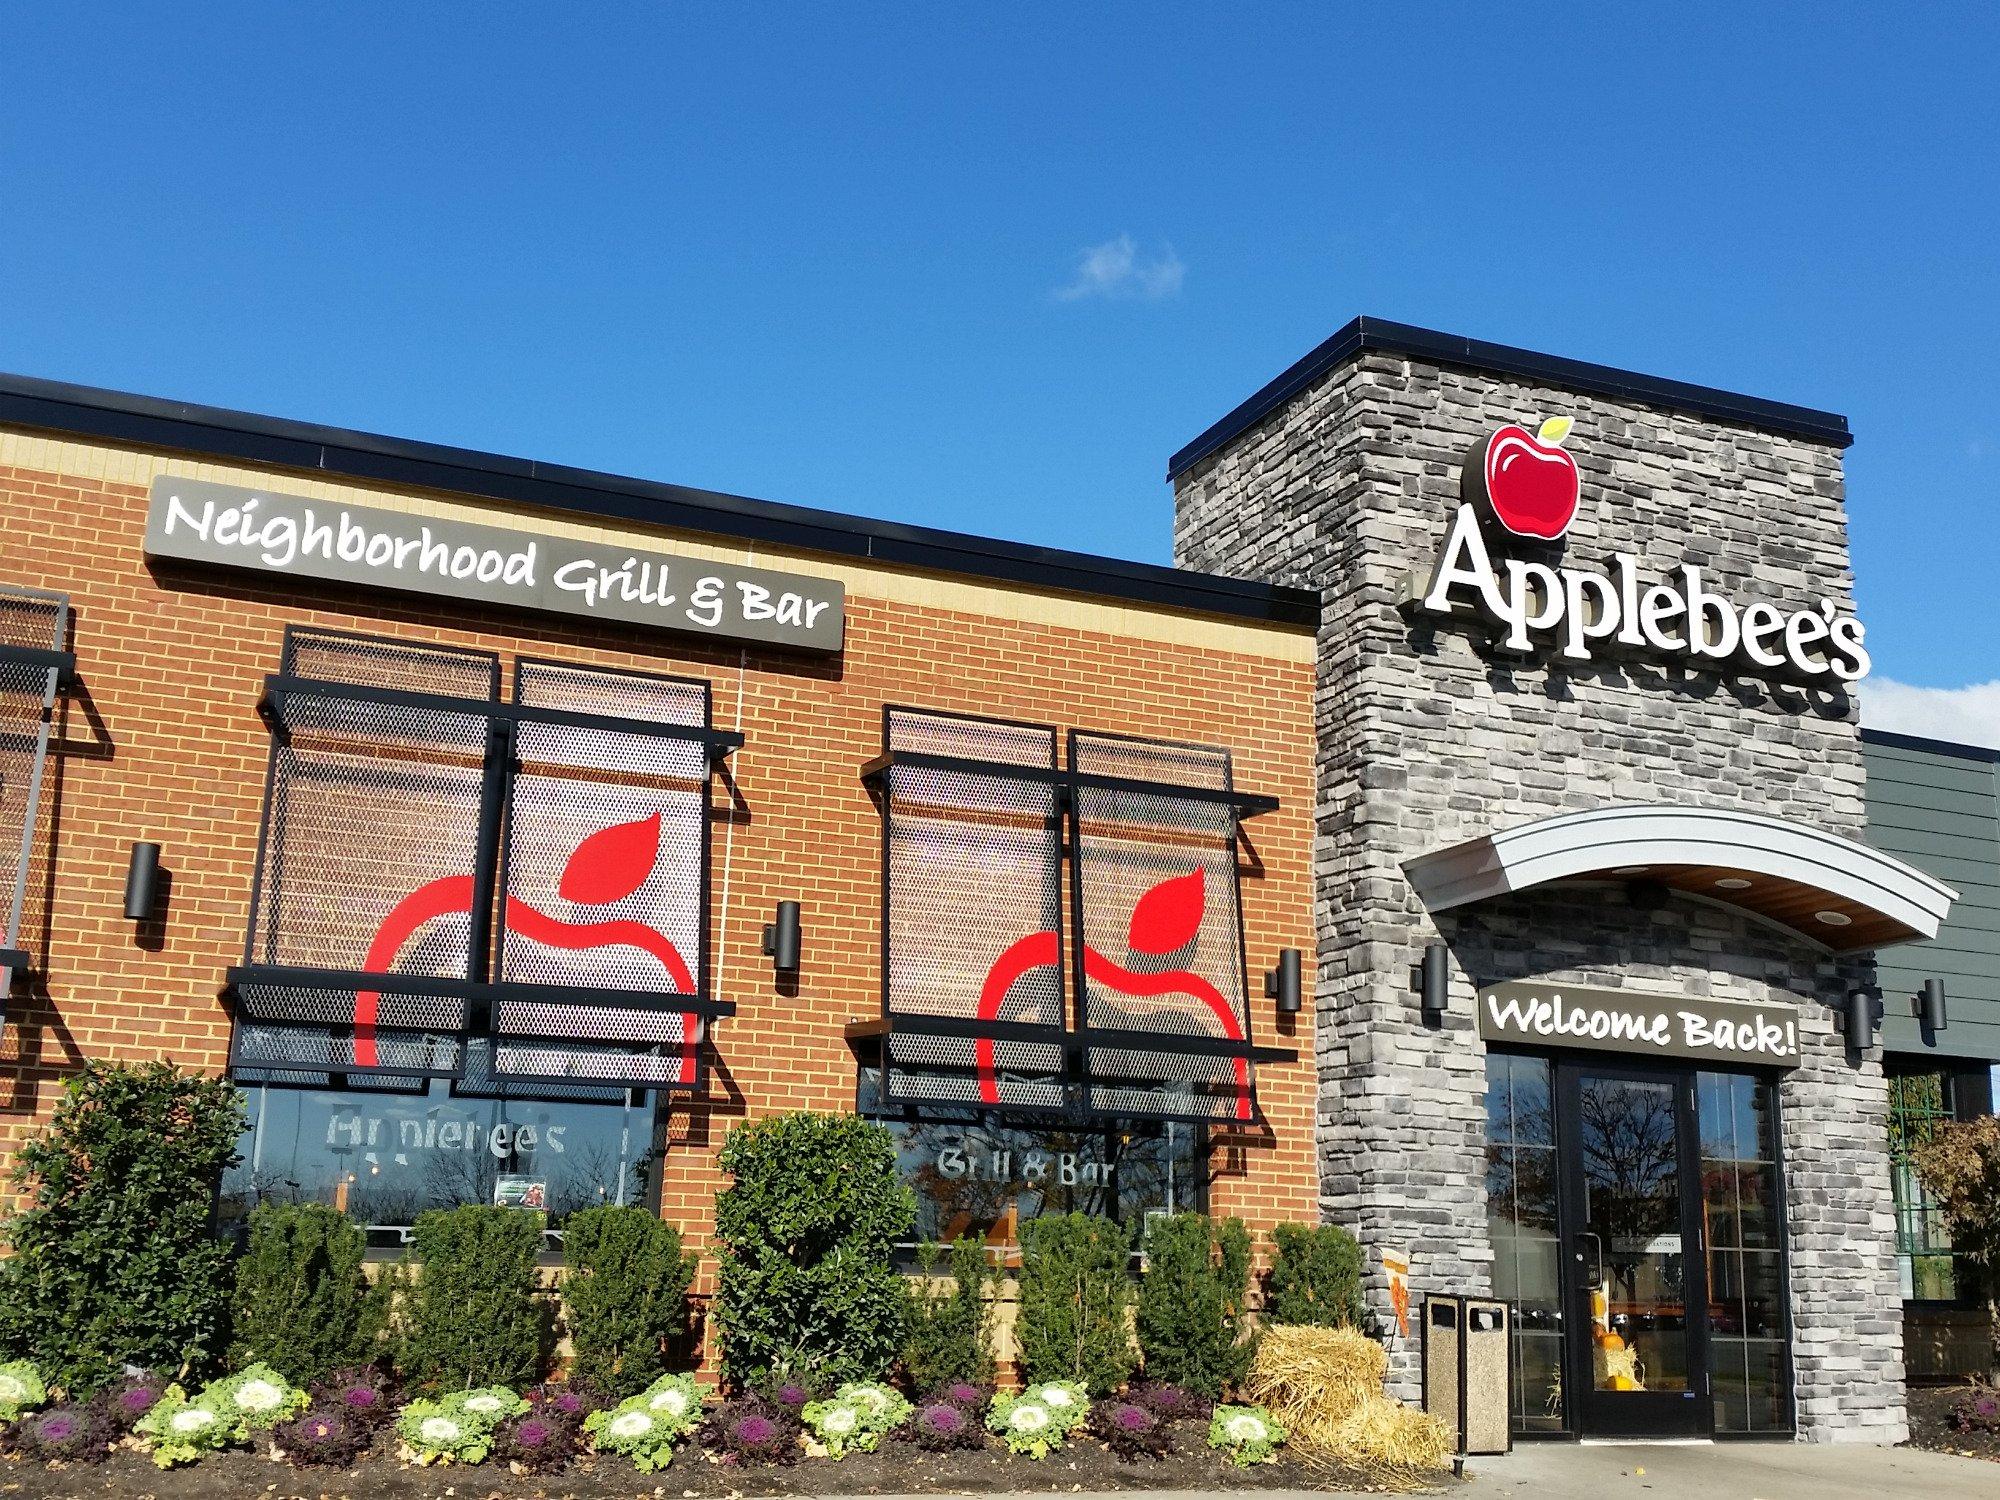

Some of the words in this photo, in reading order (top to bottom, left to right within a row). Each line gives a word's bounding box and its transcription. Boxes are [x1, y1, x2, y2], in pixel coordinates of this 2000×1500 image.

[164, 495, 537, 588] Neighborhood
[553, 556, 676, 608] Grill
[686, 576, 725, 628] &
[736, 580, 830, 630] Bar
[1424, 503, 1872, 681] Applebee's
[1487, 994, 1672, 1047] Welcome
[1677, 1011, 1798, 1057] Back!
[1060, 1152, 1115, 1187] Bar
